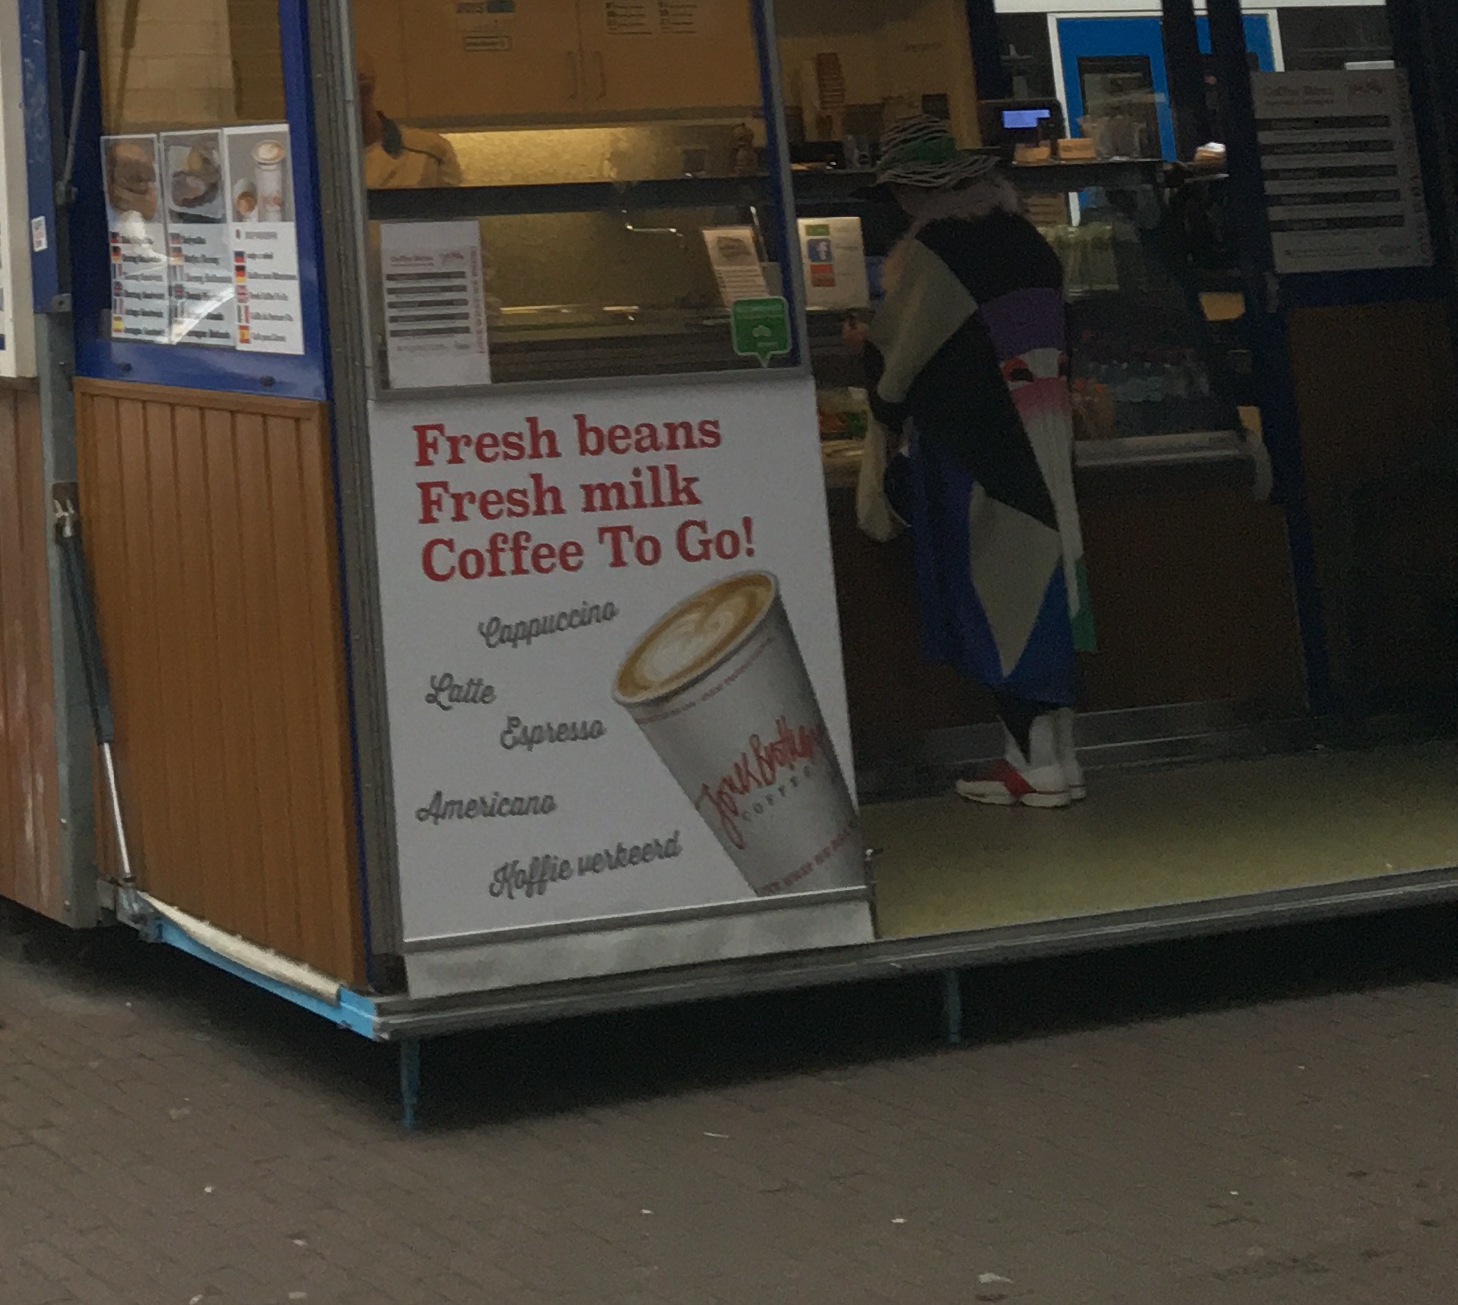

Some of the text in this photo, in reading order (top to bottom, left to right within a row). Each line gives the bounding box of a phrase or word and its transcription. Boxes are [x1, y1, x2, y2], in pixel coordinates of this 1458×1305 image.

[412, 413, 722, 467] Fresh beans
[417, 463, 702, 524] Fresh milk
[421, 515, 756, 582] Coffee To Go!
[477, 600, 620, 648] Cappuccino
[425, 672, 497, 711] Latte
[500, 715, 607, 752] Espresso
[415, 790, 558, 826] Americano
[488, 830, 683, 900] Koffie verkeerd
